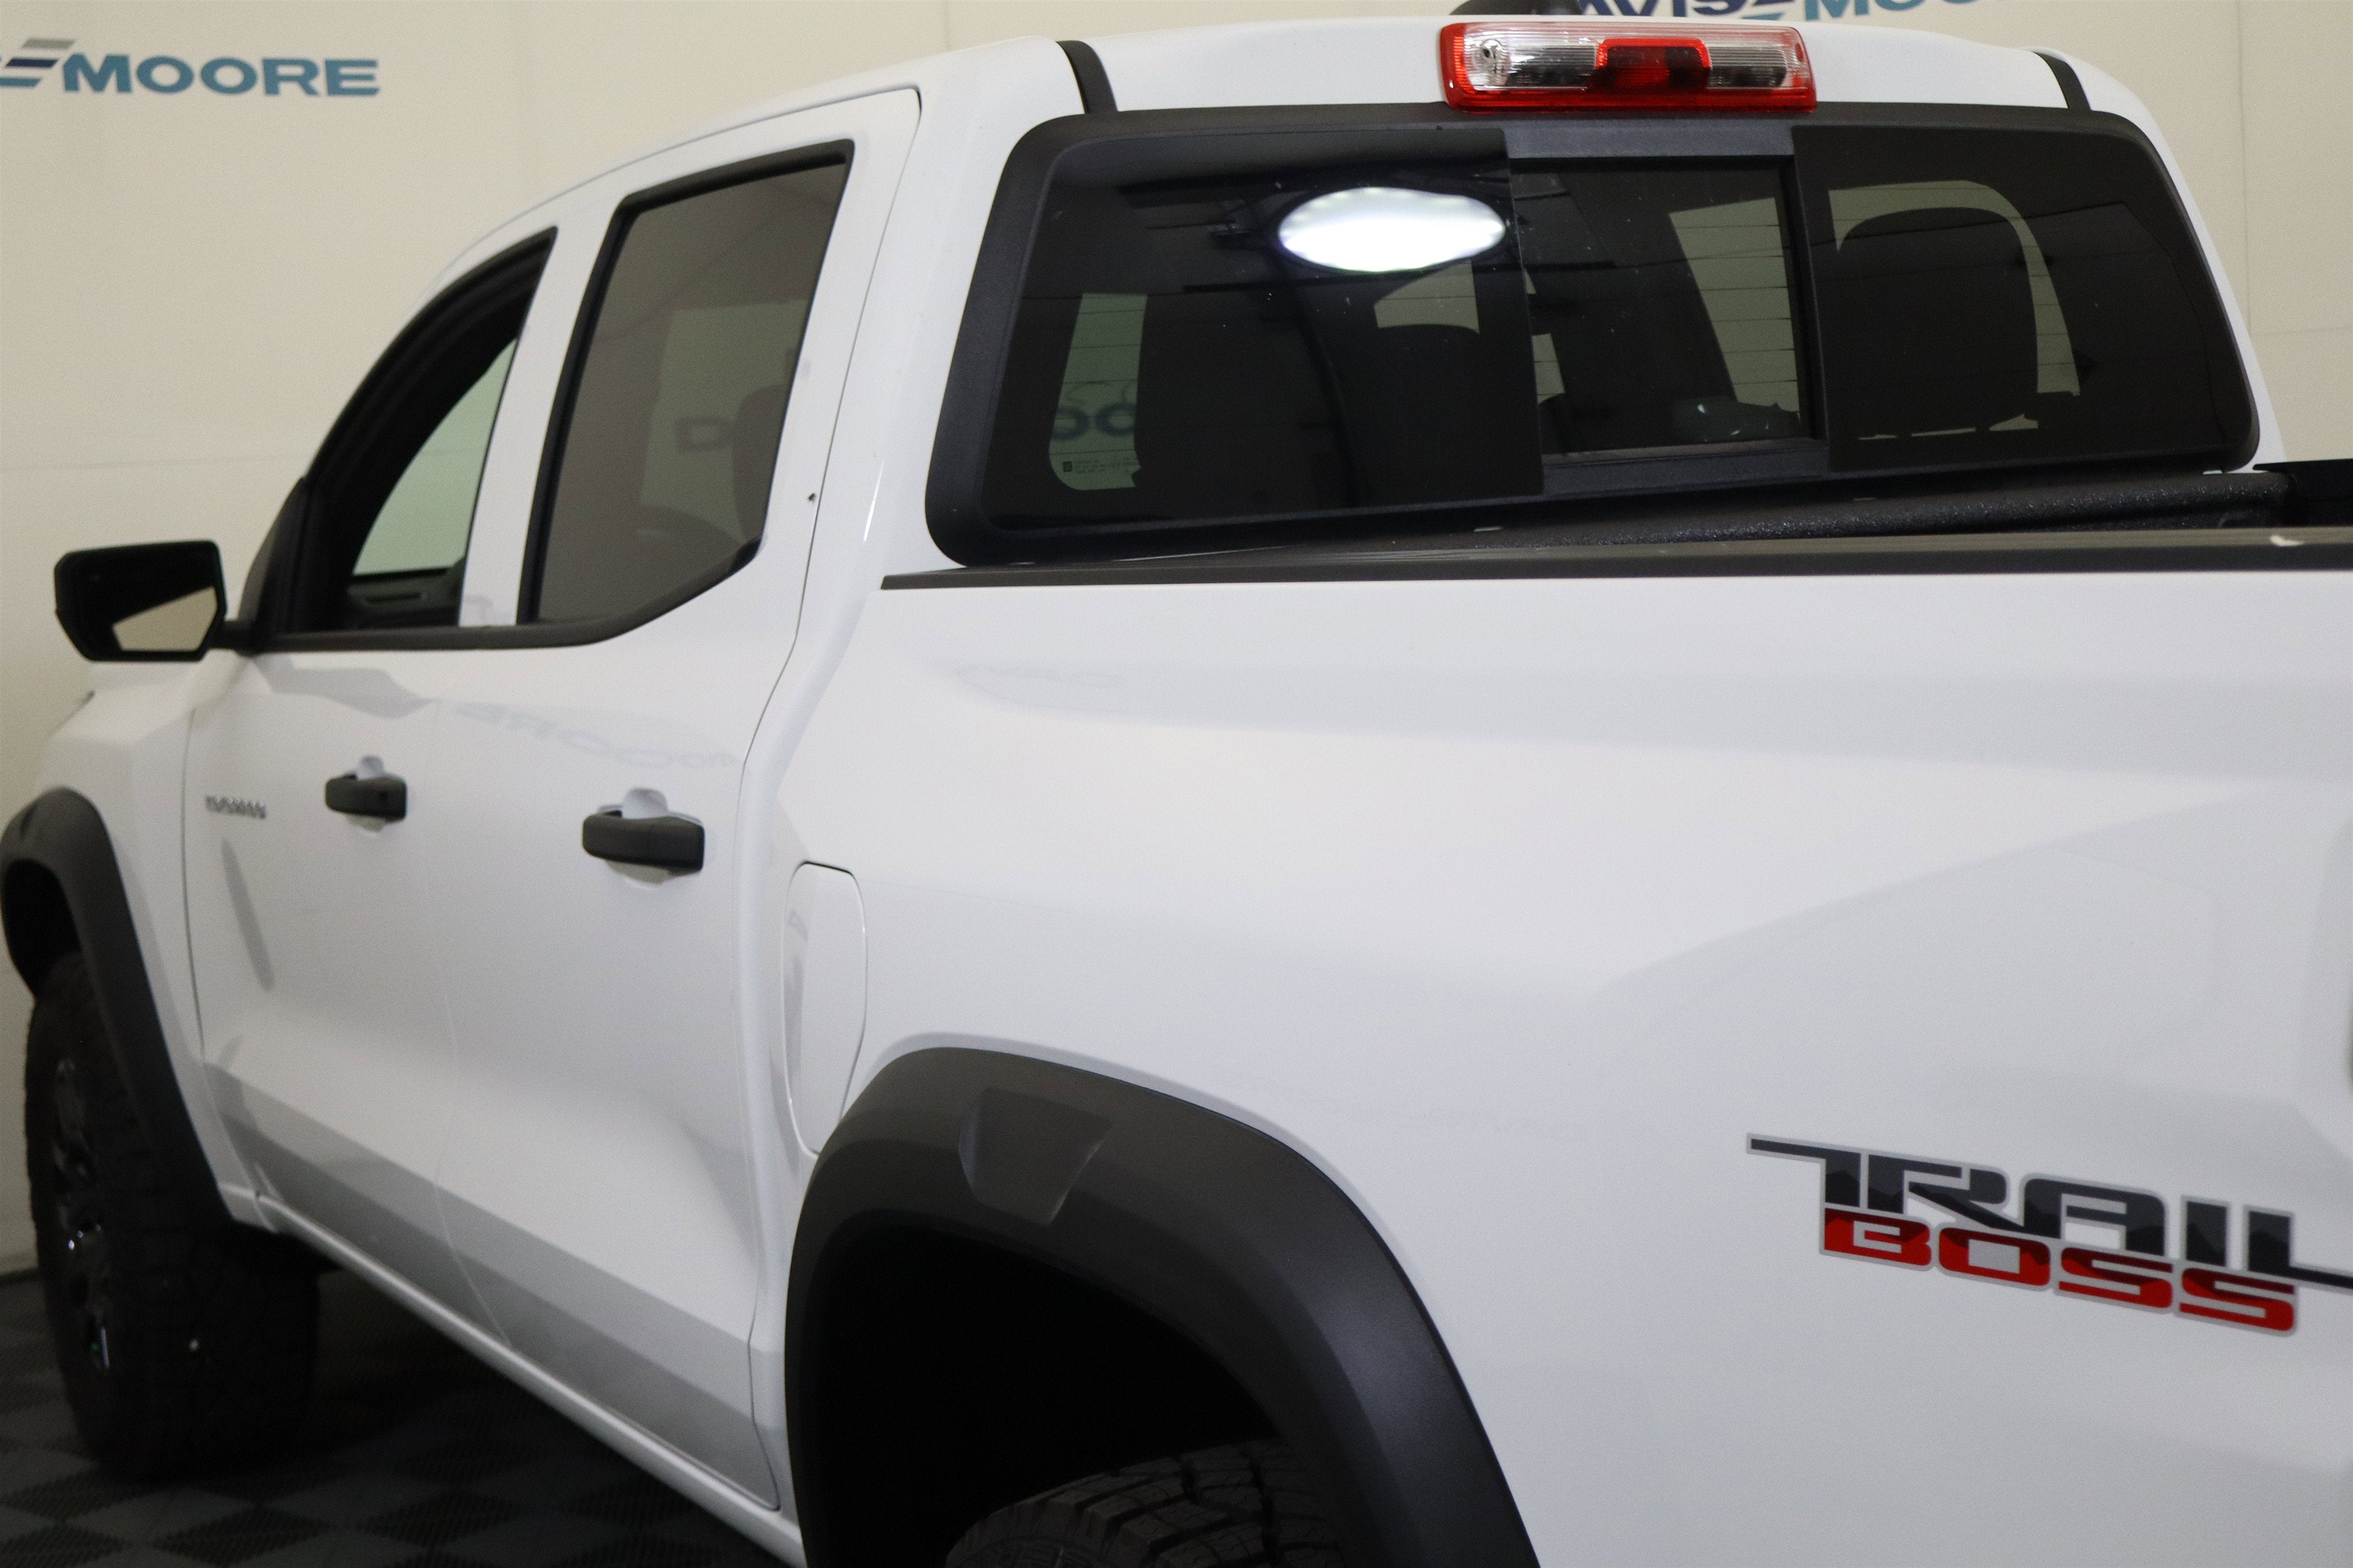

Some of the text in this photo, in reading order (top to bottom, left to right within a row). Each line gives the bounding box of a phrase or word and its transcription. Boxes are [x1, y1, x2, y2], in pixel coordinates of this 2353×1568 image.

[62, 52, 380, 96] MOORE
[1747, 1133, 2353, 1295] TRAIL
[1820, 1206, 2297, 1337] BOSS
